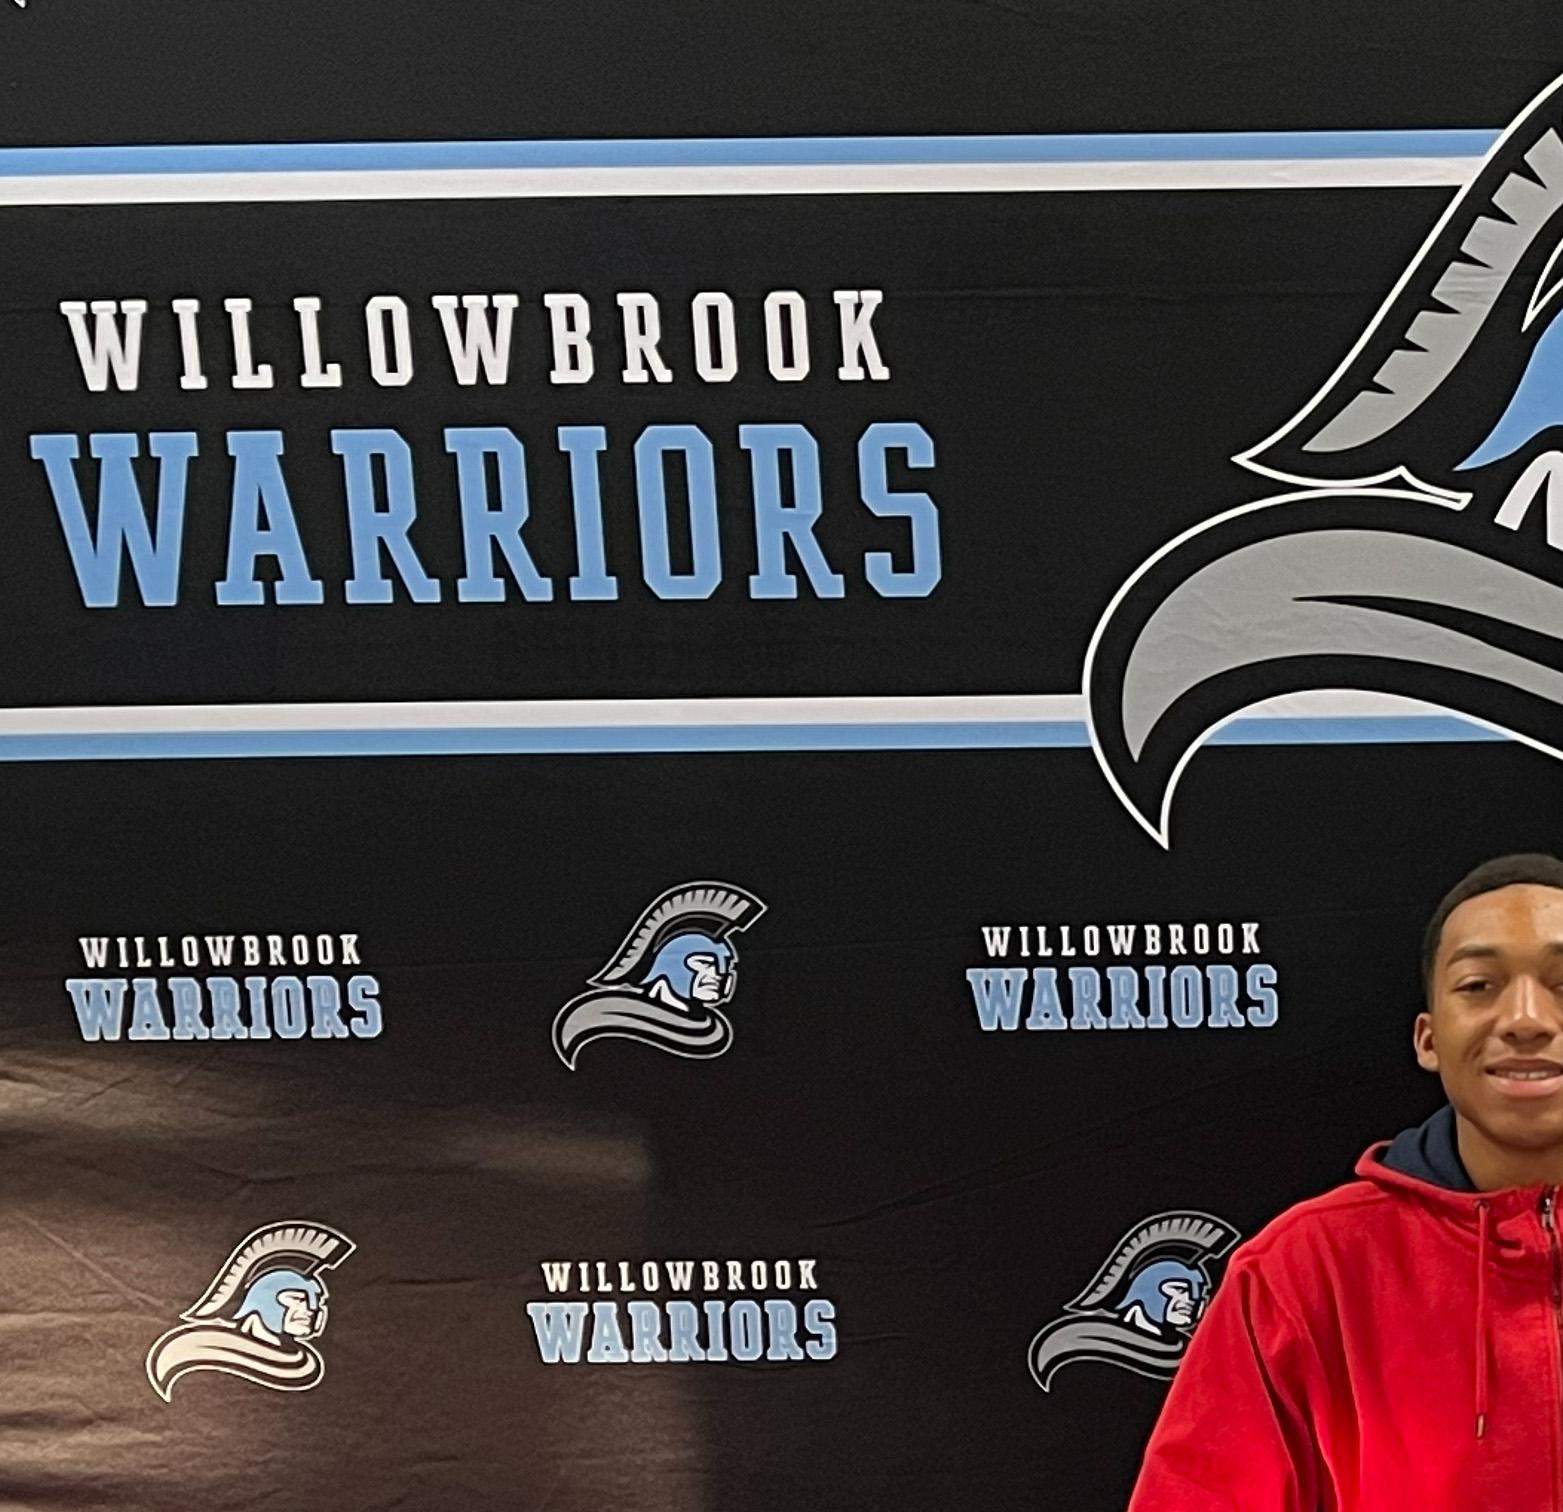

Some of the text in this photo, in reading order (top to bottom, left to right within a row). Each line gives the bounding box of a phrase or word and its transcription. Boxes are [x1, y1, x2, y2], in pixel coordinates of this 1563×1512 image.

[60, 289, 890, 391] WILLOWBROOK
[30, 422, 942, 608] WARRIORS
[79, 933, 361, 968] WILLOWBROOK
[981, 922, 1260, 957] WILLOWBROOK
[65, 975, 383, 1041] WARRIORS
[965, 963, 1279, 1031] WARRIORS
[542, 1259, 818, 1293] WILLOWBROOK
[526, 1299, 837, 1364] WARRIORS
